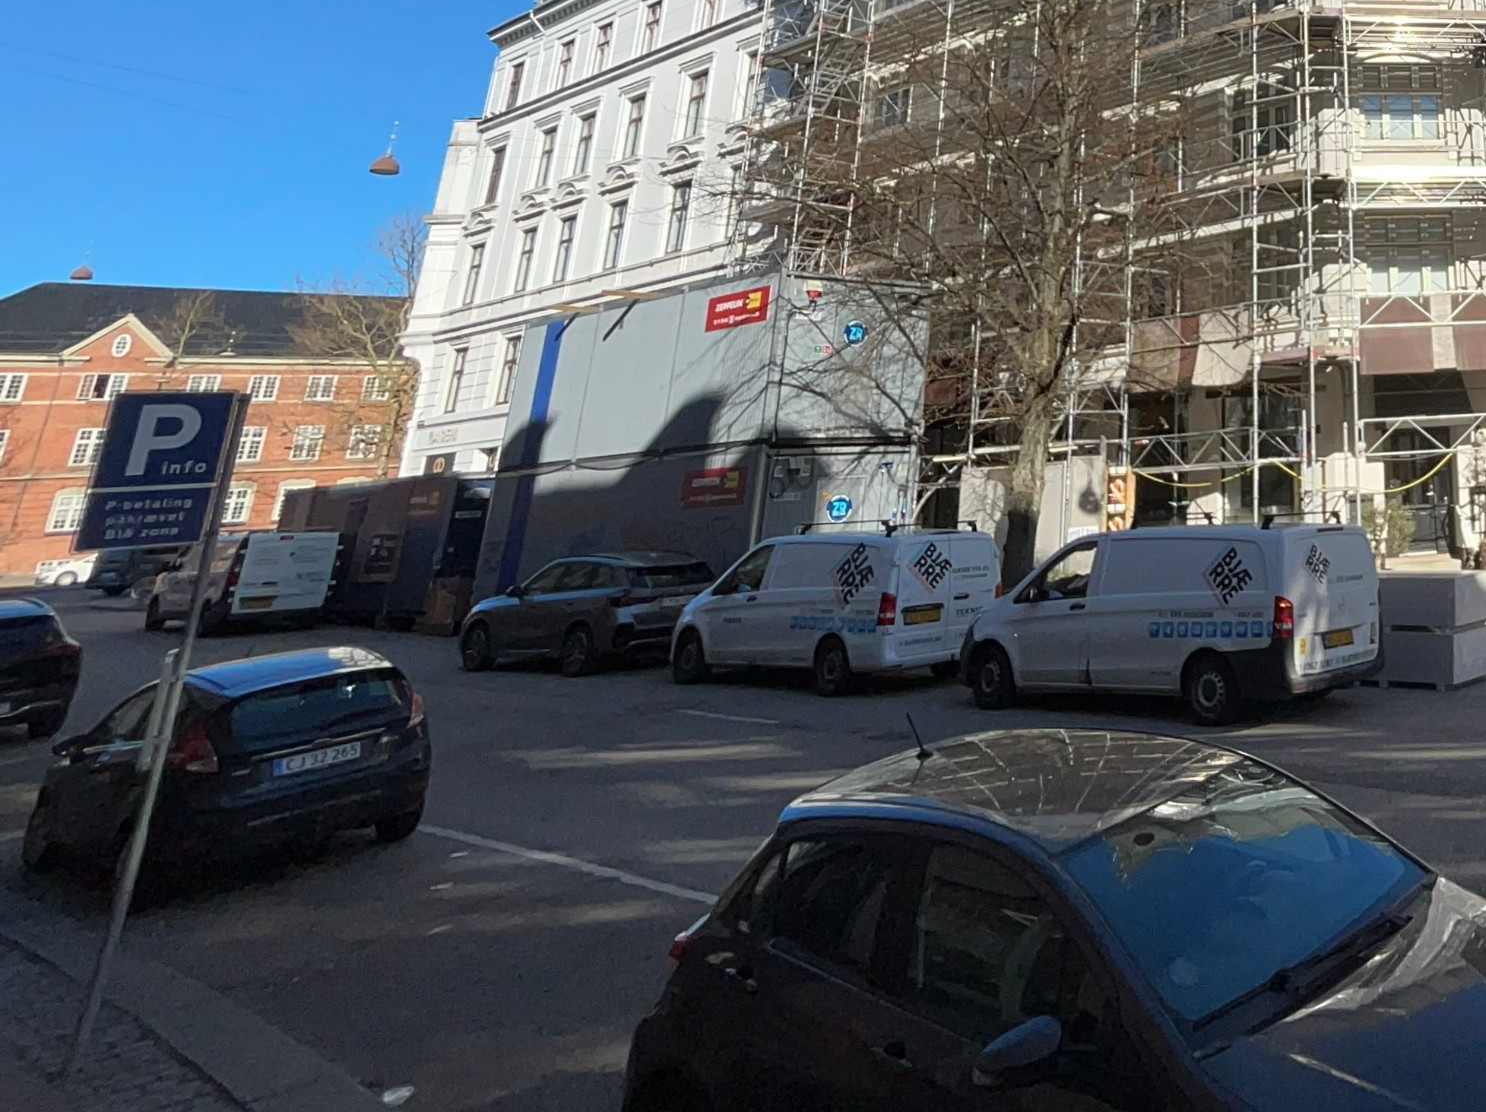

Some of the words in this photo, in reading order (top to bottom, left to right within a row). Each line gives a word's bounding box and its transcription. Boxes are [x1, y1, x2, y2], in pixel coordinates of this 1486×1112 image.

[125, 404, 202, 477] P
[161, 459, 207, 475] info
[105, 498, 193, 510] P-betaling
[836, 558, 859, 605] RRE
[913, 555, 943, 589] RRE
[1208, 561, 1238, 605] RRE
[1305, 555, 1327, 584] RRE
[286, 756, 306, 771] CJ
[331, 743, 358, 761] 265
